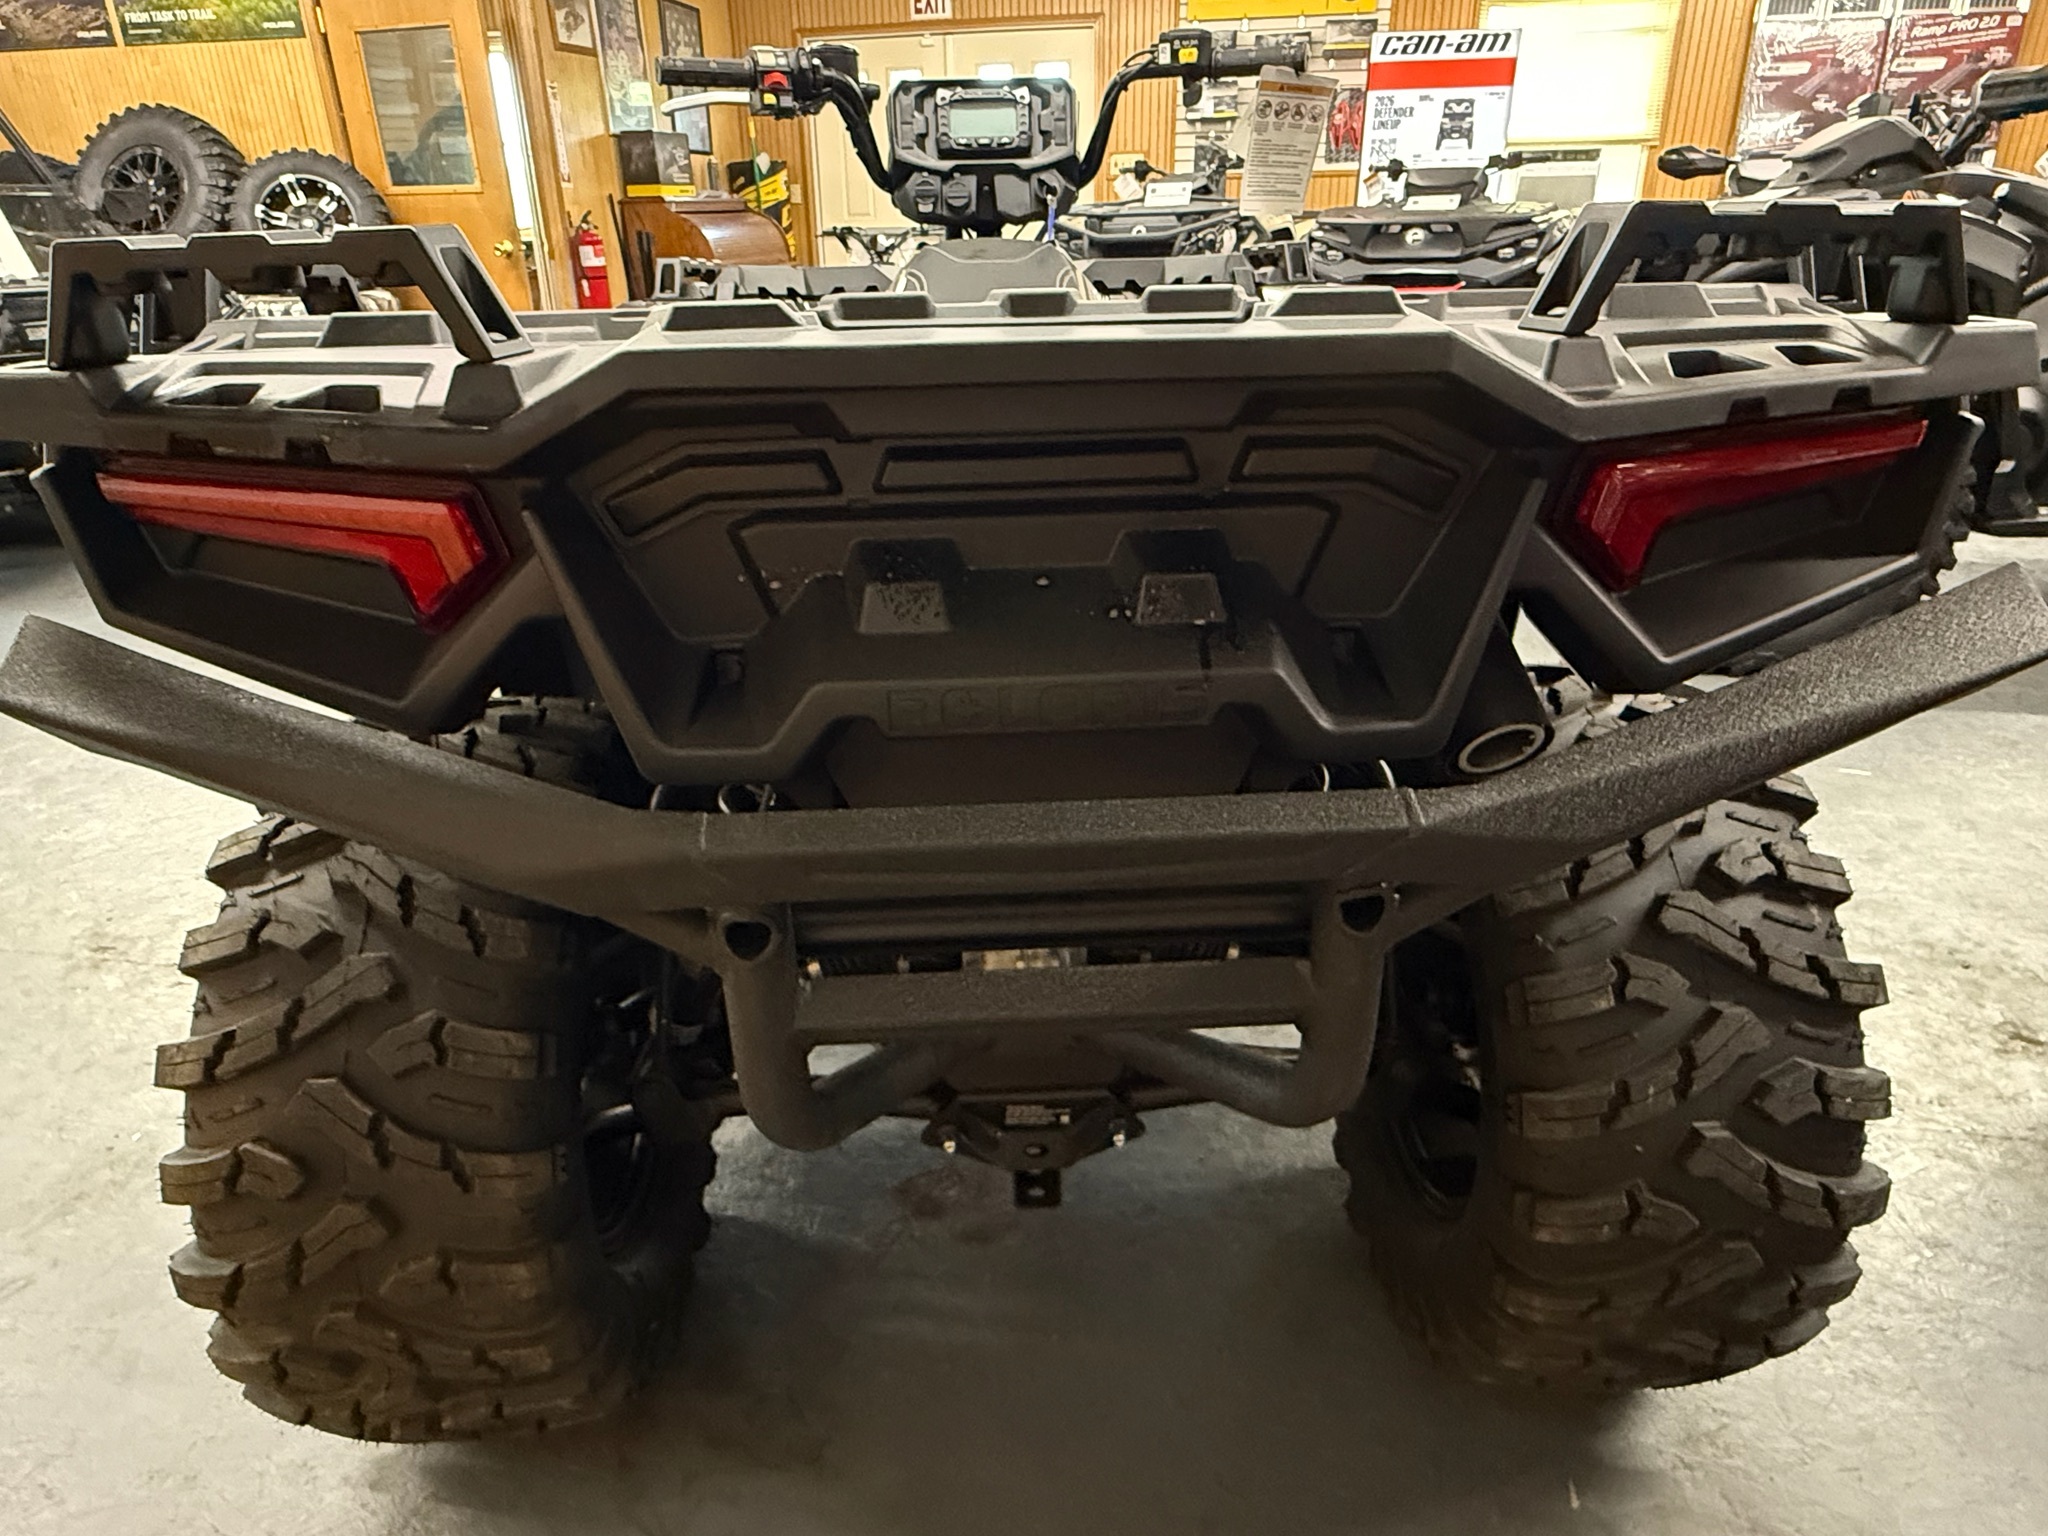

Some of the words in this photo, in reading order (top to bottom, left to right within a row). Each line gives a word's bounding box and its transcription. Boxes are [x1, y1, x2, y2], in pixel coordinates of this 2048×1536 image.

[914, 0, 946, 15] EXIT
[124, 12, 151, 24] FROM
[150, 10, 175, 22] TASK
[175, 9, 188, 21] TO
[1910, 25, 1947, 38] Ramp
[1948, 18, 1979, 32] PRO
[1374, 106, 1415, 119] DEFENDER
[1372, 119, 1402, 131] LINEUP
